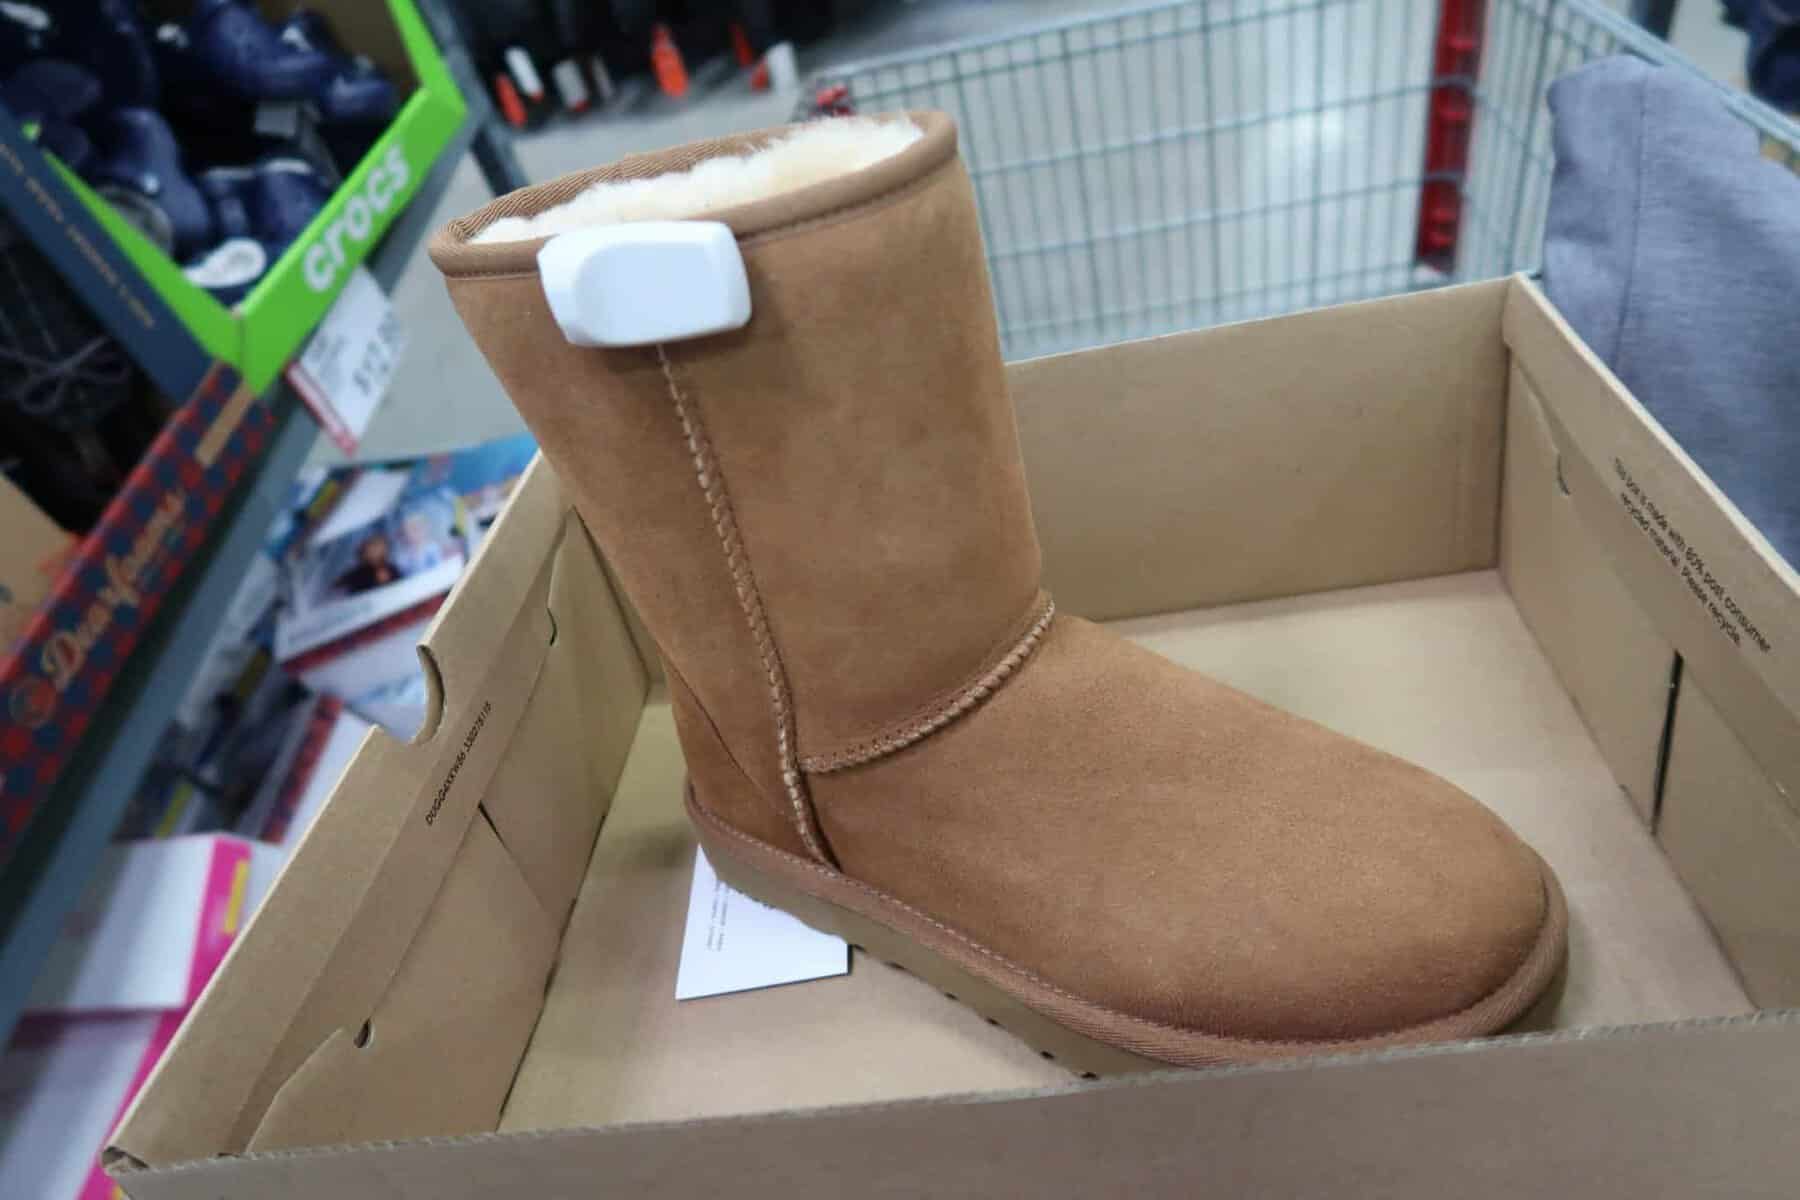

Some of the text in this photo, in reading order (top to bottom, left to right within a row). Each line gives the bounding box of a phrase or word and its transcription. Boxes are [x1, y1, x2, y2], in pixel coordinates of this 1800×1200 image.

[303, 144, 409, 291] crocs
[1621, 492, 1650, 531] recycled
[1647, 501, 1668, 531] made
[1668, 525, 1686, 551] with
[1704, 572, 1726, 597] post
[1724, 596, 1772, 653] consumer
